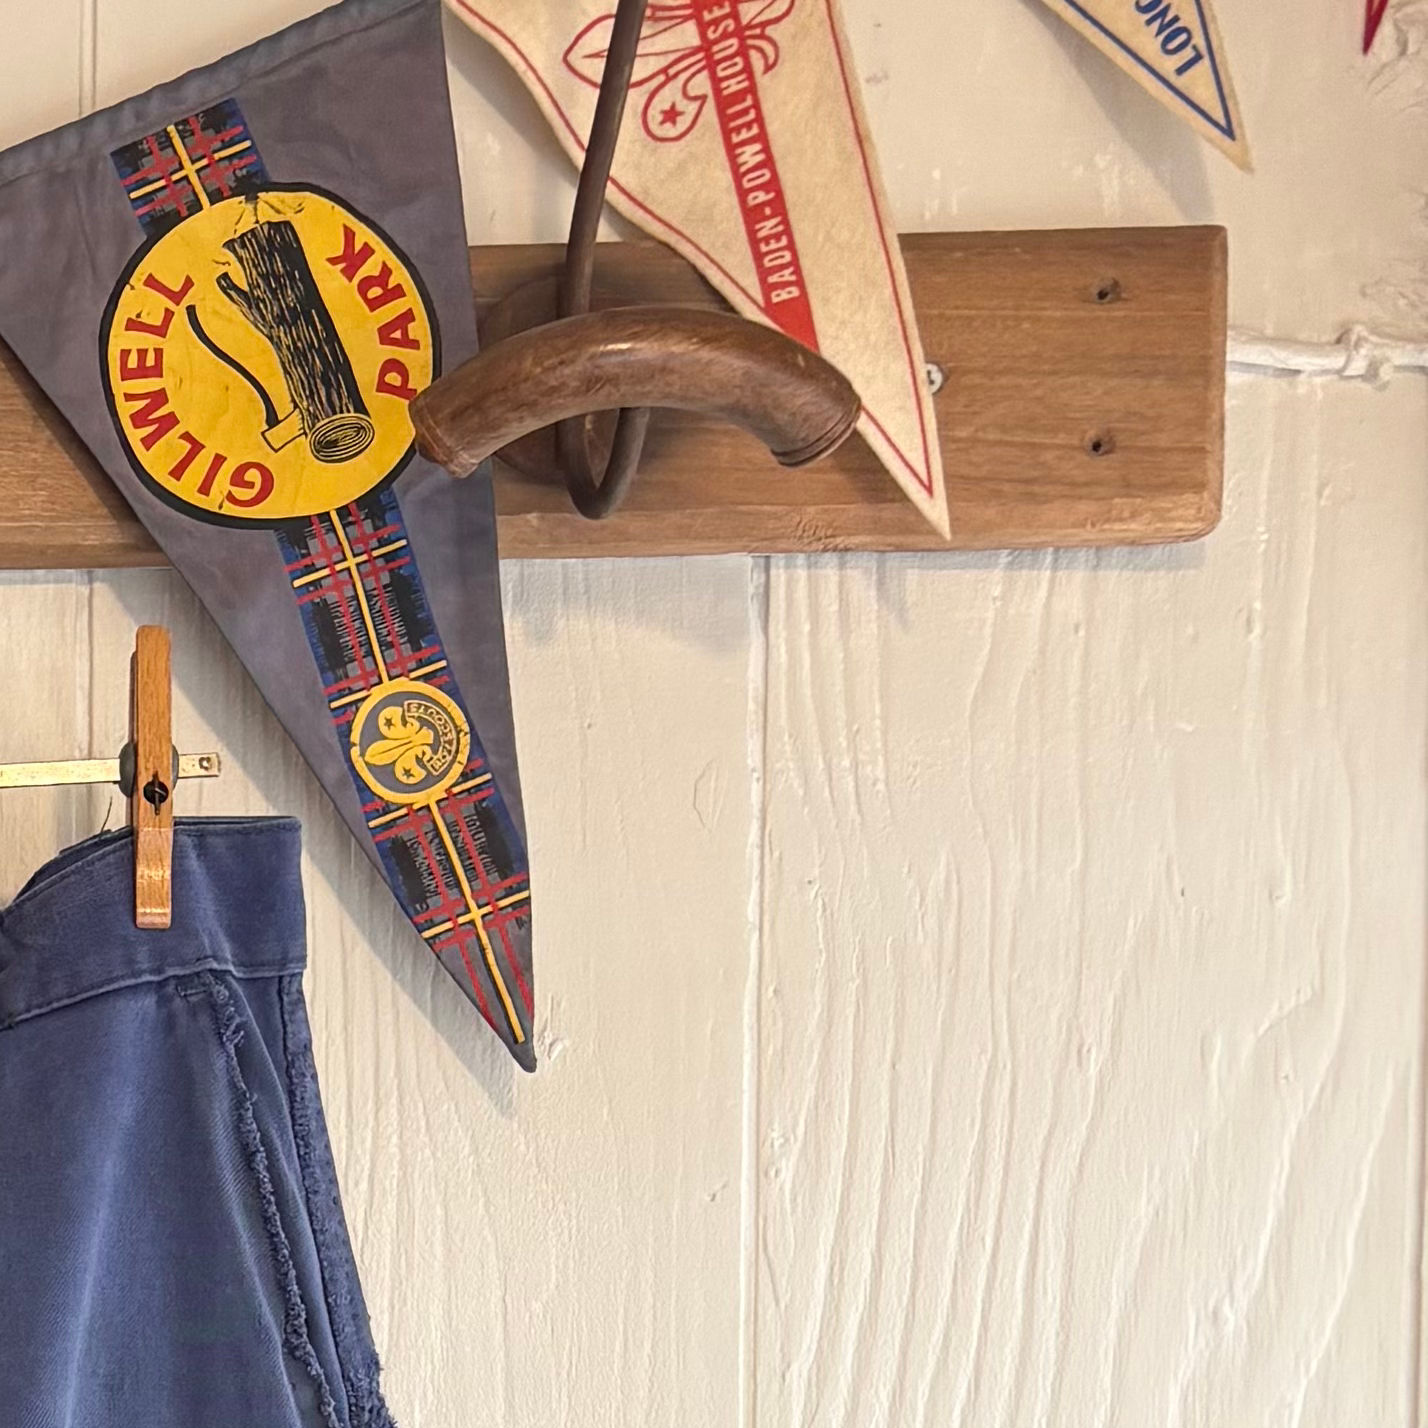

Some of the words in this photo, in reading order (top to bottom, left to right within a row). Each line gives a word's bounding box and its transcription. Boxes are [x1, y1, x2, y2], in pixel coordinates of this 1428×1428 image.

[703, 1, 750, 96] HOUSE
[120, 272, 274, 508] GILWELL
[325, 223, 421, 401] PARK
[408, 702, 453, 741] SCOUTS
